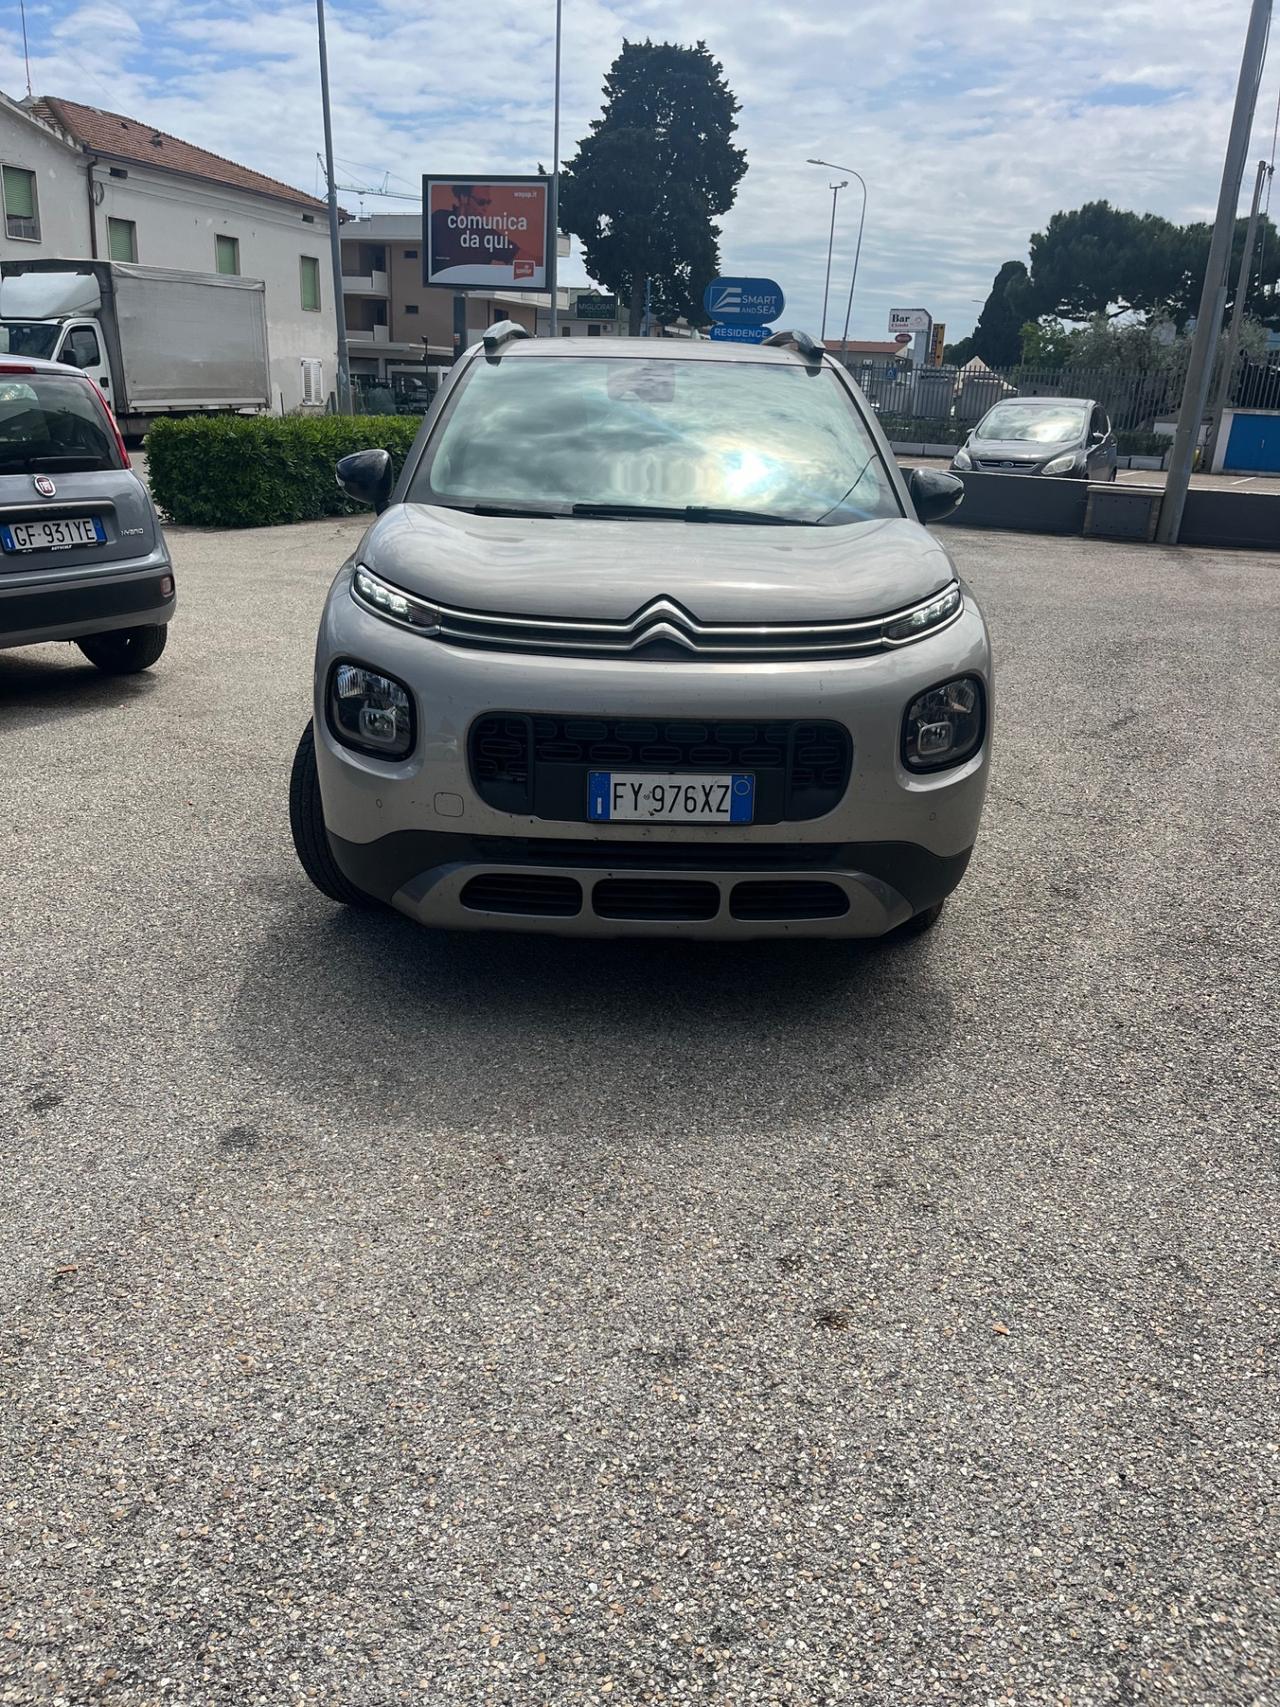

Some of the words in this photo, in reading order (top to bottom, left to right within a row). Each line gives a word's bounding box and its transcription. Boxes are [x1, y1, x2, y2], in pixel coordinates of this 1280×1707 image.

[447, 211, 527, 230] comunica
[460, 230, 480, 248] da
[484, 231, 513, 252] qui.
[742, 295, 777, 305] SMART
[892, 314, 910, 323] Bar
[714, 328, 768, 338] RESIDENCE
